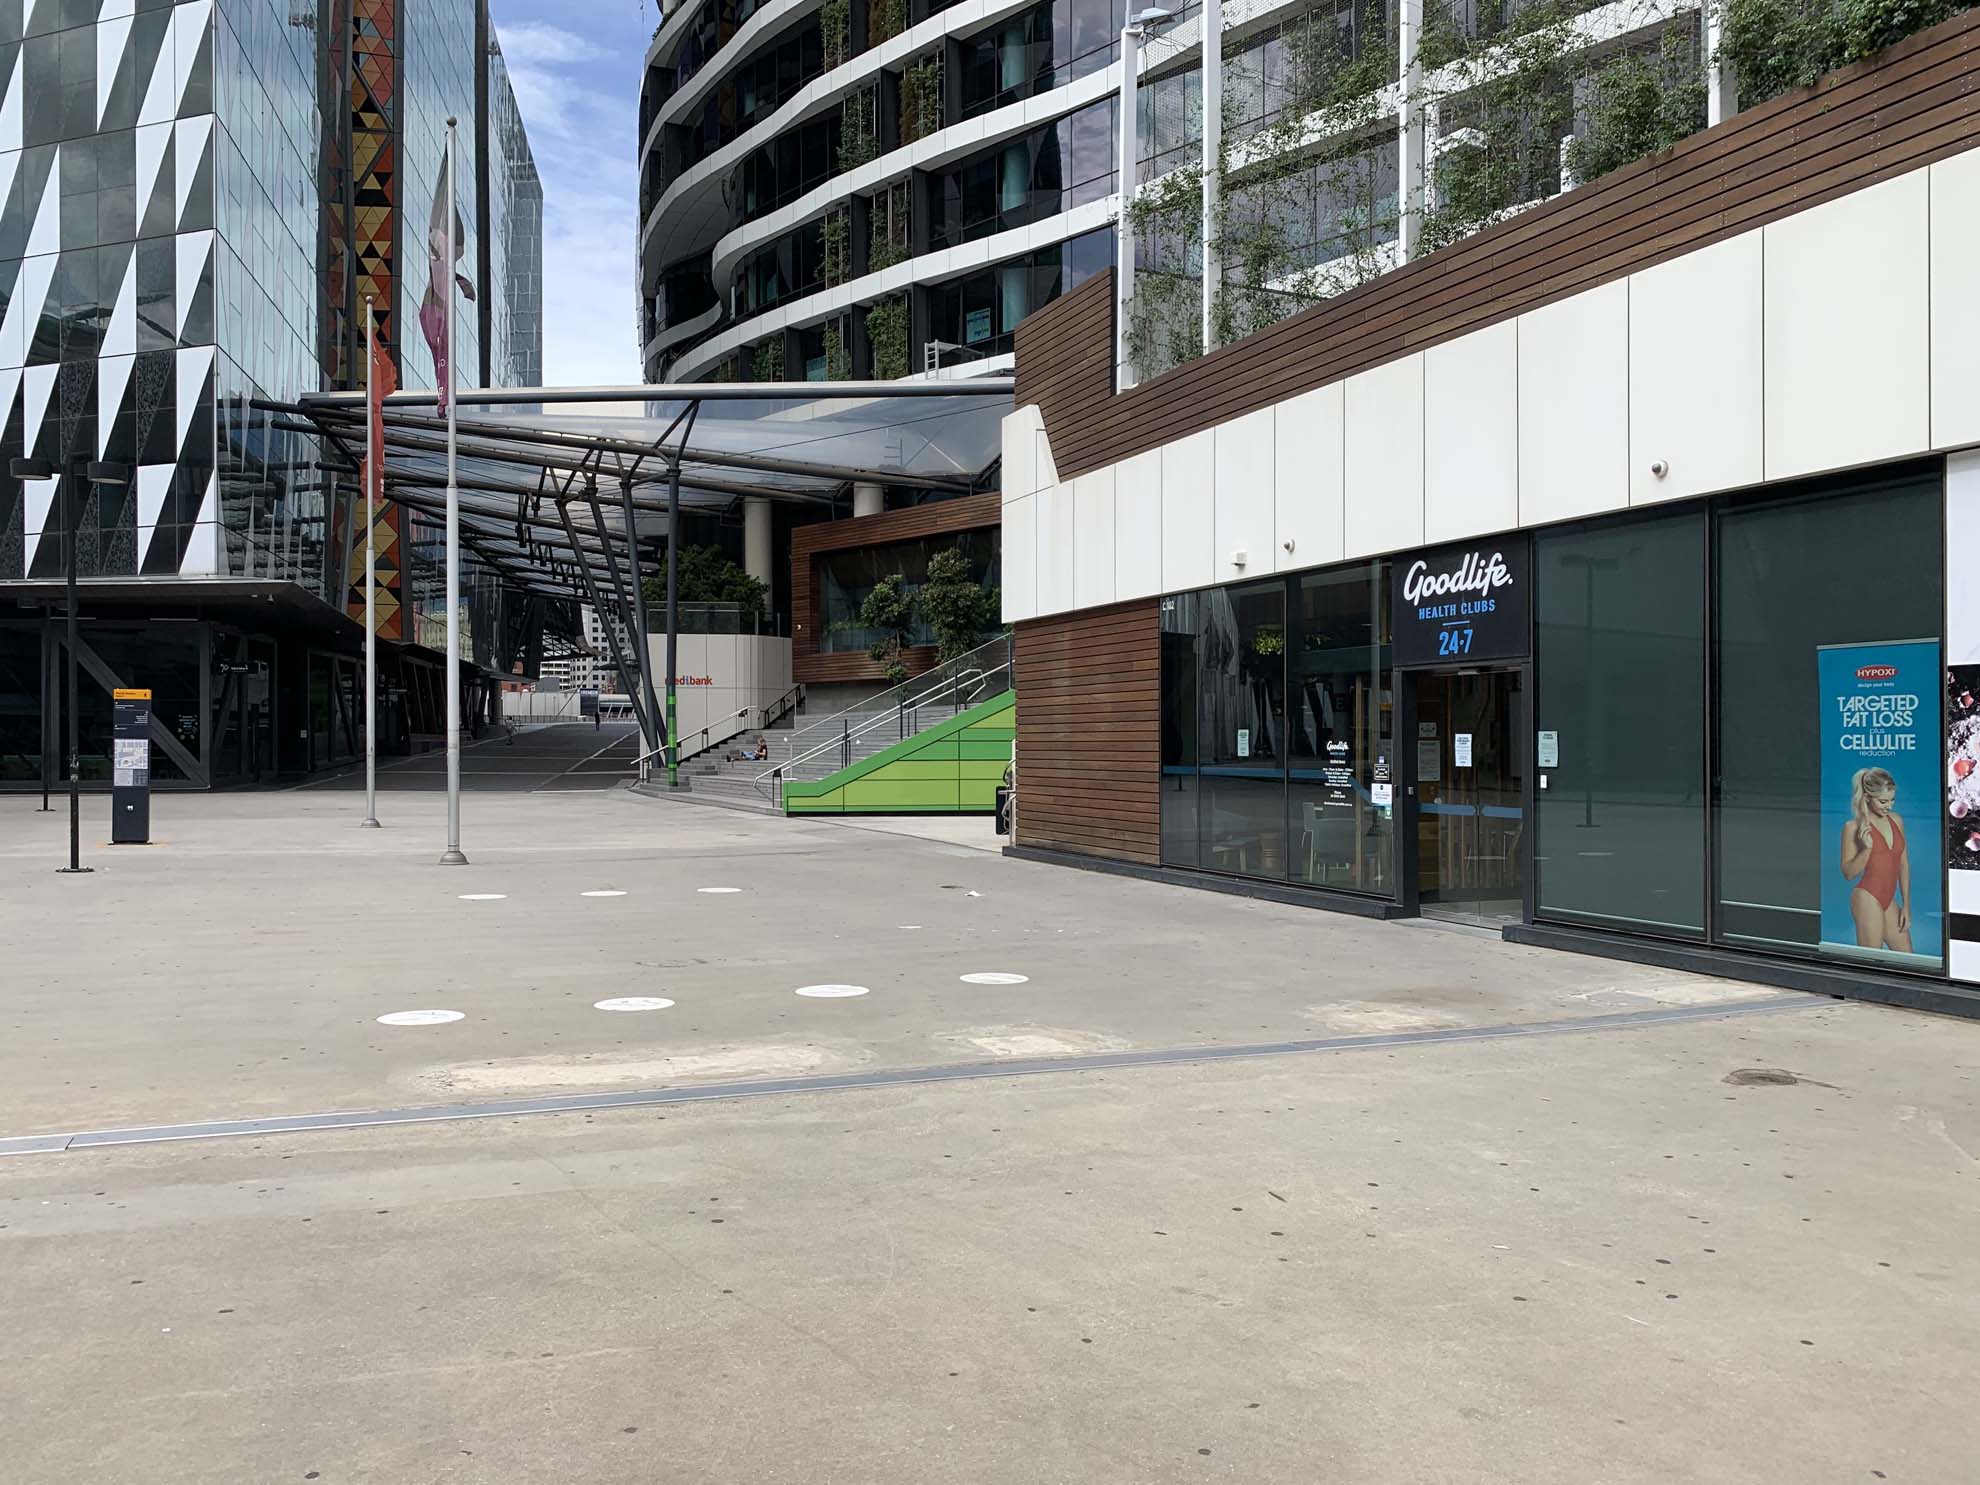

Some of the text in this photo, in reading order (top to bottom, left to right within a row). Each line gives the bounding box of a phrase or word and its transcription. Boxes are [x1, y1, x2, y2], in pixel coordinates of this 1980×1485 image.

[1419, 600, 1496, 619] HEALTH CLUBS
[664, 675, 713, 686] edibank
[1857, 668, 1896, 677] HYPOXI
[1837, 694, 1919, 711] TARGETED
[1843, 711, 1913, 728] FAT LOSS
[1840, 734, 1916, 750] CELLULITE
